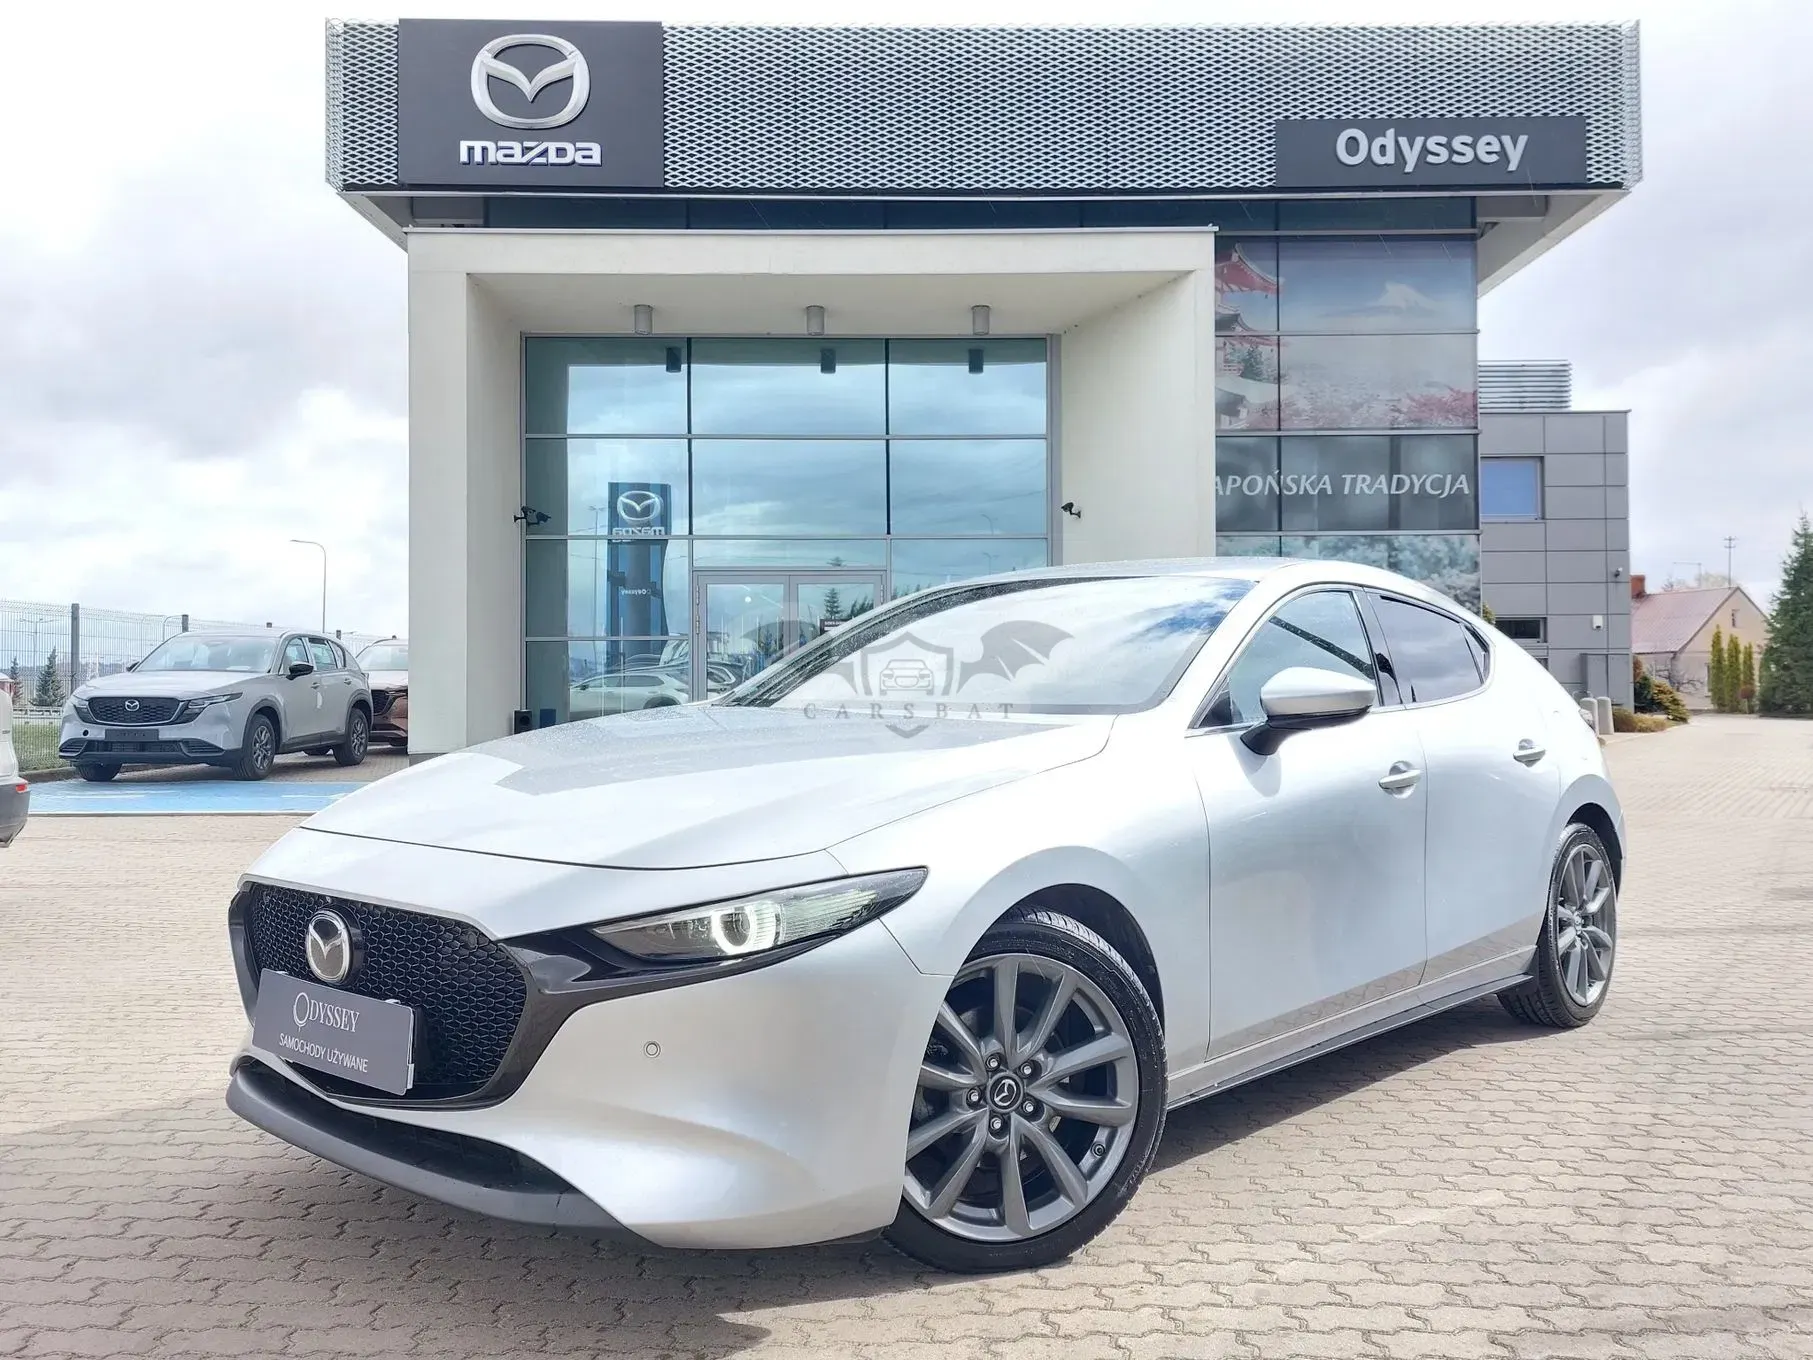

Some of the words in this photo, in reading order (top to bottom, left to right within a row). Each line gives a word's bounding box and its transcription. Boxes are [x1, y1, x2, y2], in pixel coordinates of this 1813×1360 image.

[459, 140, 602, 167] mazda
[1336, 127, 1529, 174] Odyssey
[1341, 474, 1470, 499] TRADYCJA
[293, 991, 361, 1033] ODYSSEY
[278, 1032, 327, 1060] SAMOCHODY
[327, 1047, 369, 1073] UŻYWANE
